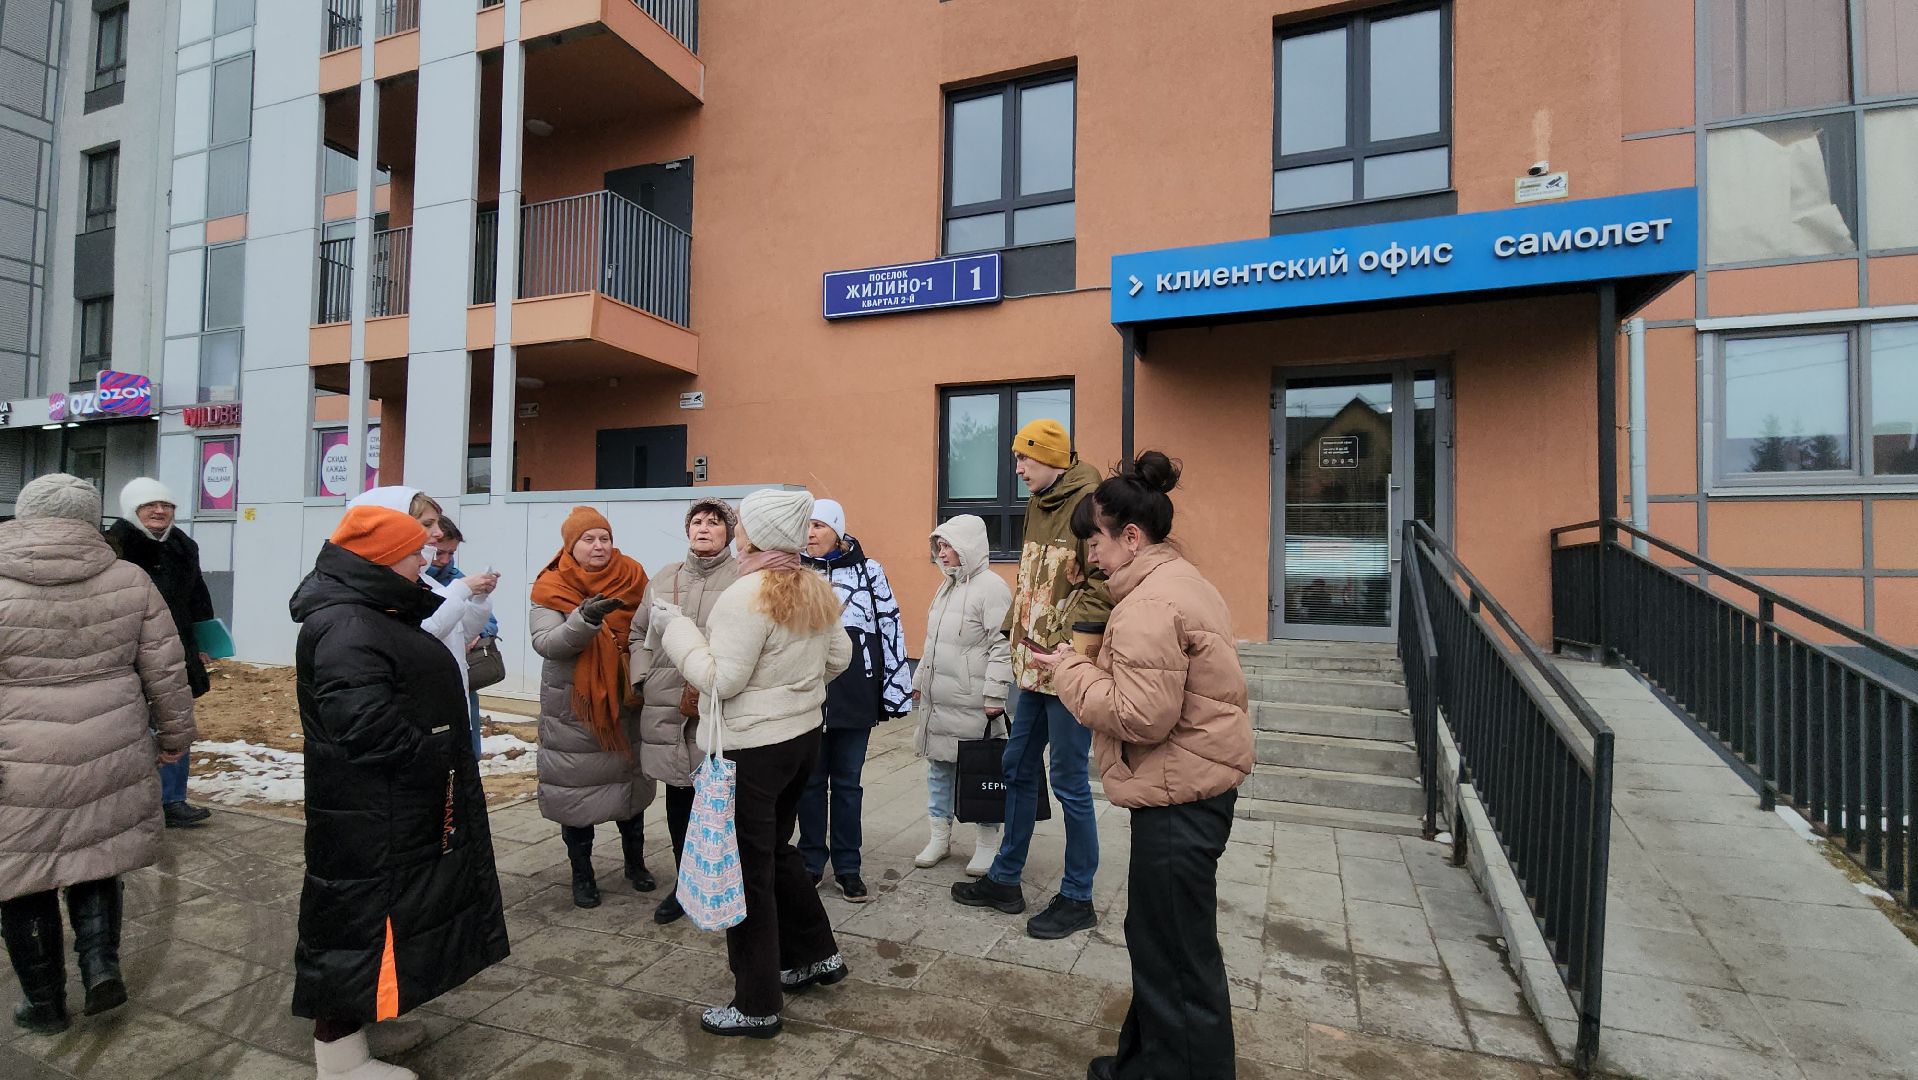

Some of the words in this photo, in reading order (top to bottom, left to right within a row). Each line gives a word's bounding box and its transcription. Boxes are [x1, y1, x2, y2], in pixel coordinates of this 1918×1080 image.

[1156, 247, 1349, 292] клиентский
[1358, 241, 1453, 275] офис
[1494, 217, 1673, 258] самолет
[869, 270, 908, 282] ПОСЕЛОК
[970, 266, 981, 291] 1
[845, 277, 933, 300] ЖИЛИНО-1
[862, 296, 899, 308] КВАРТАЛ
[901, 293, 915, 304] 2-Й
[100, 386, 151, 400] OZON
